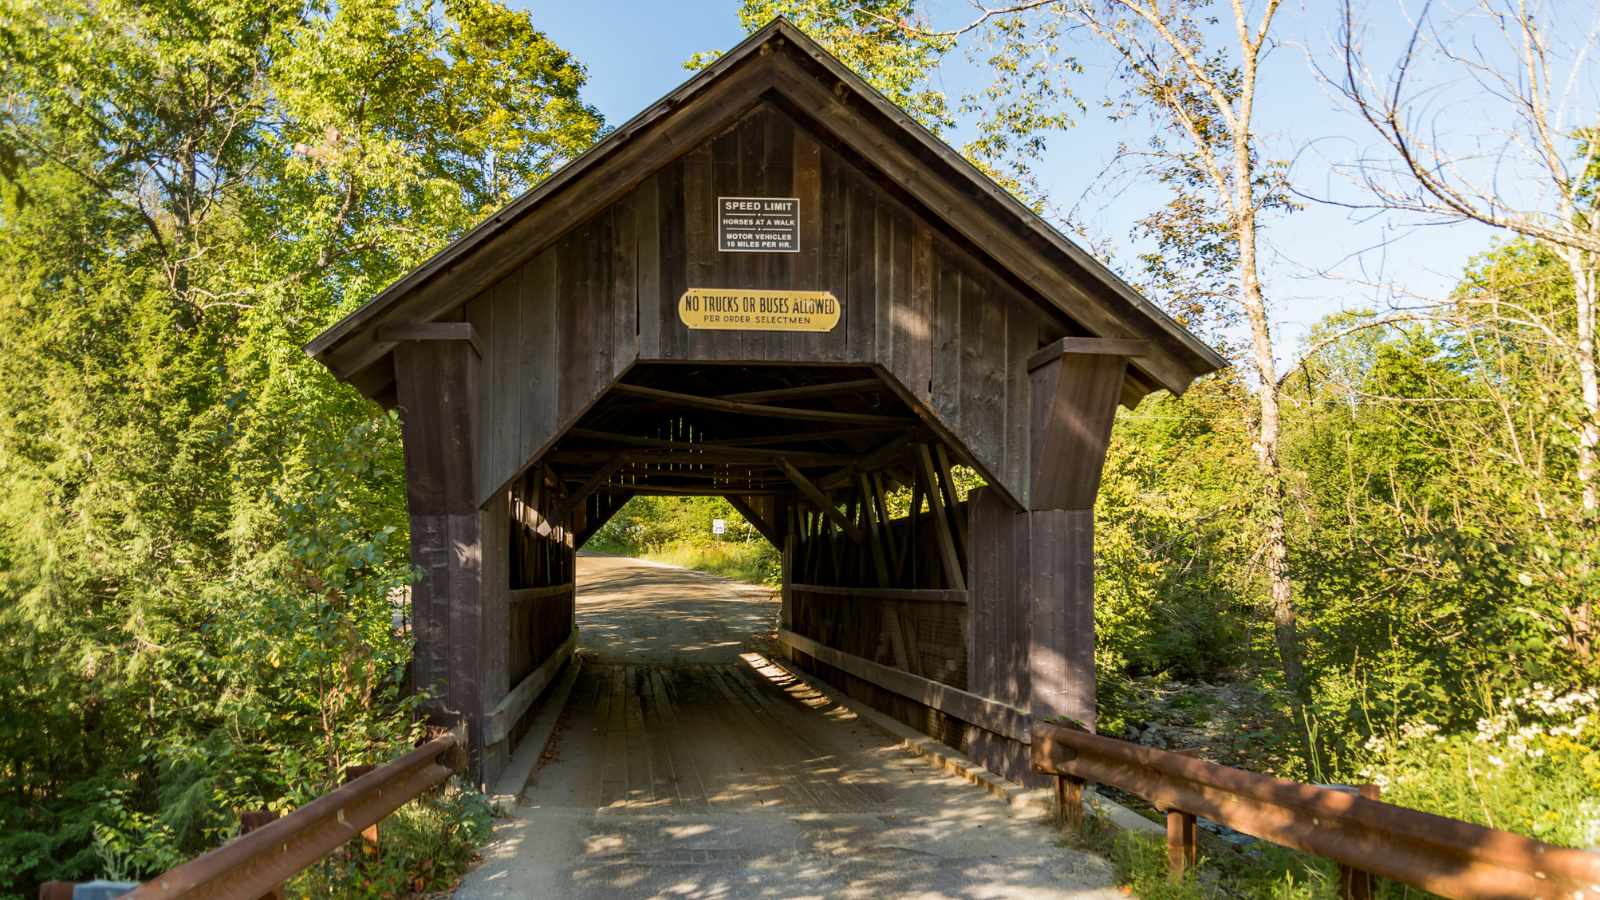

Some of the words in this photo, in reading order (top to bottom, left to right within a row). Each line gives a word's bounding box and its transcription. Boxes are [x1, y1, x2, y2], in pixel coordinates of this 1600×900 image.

[725, 201, 761, 211] SPEED
[764, 202, 793, 211] LIMIT
[754, 233, 792, 241] VEHICLES
[685, 295, 699, 312] NO
[703, 296, 739, 313] TRUCKS
[742, 296, 756, 313] OR
[759, 297, 789, 314] BUSES
[792, 298, 835, 315] ALLOWED
[703, 315, 721, 323] PER
[723, 315, 751, 323] ORDER
[755, 315, 811, 324] SELECTMEN
